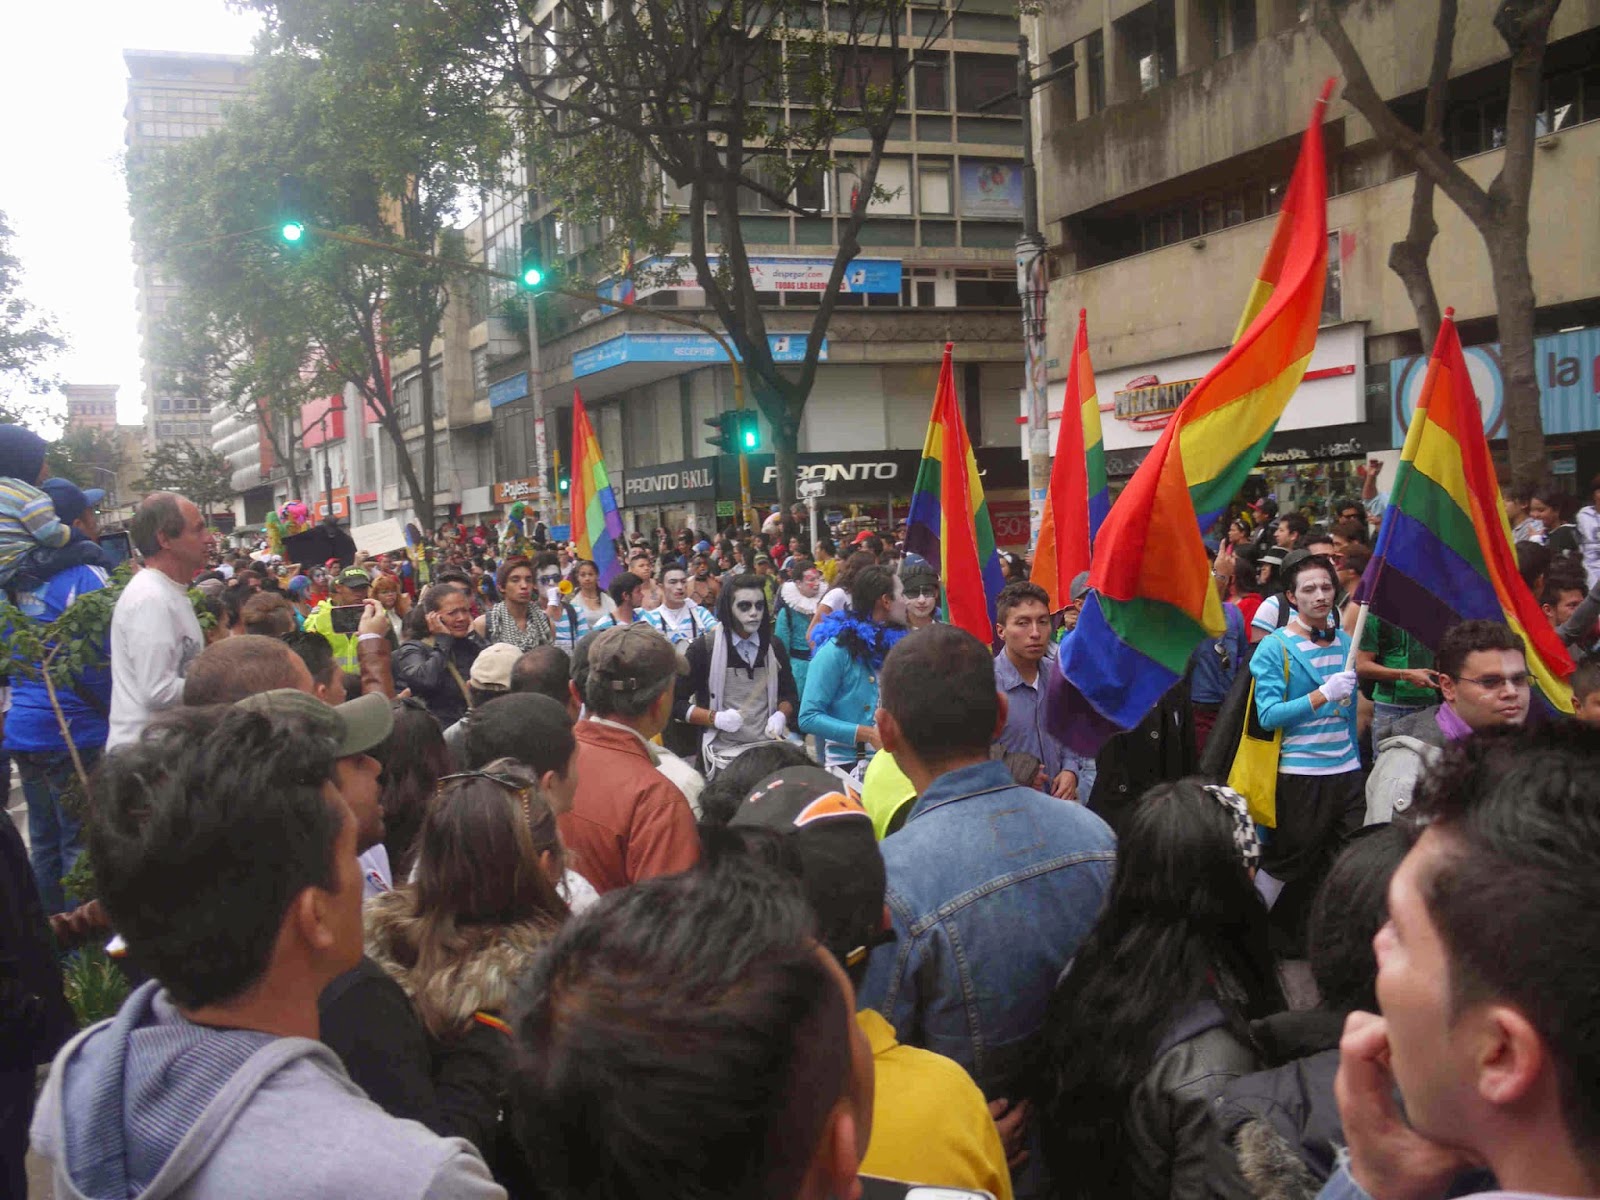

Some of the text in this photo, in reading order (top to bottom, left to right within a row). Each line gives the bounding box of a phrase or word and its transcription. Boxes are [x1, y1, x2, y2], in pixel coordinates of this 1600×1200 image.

[797, 282, 808, 290] LAS
[1549, 352, 1580, 388] la
[625, 473, 679, 495] PRONTO
